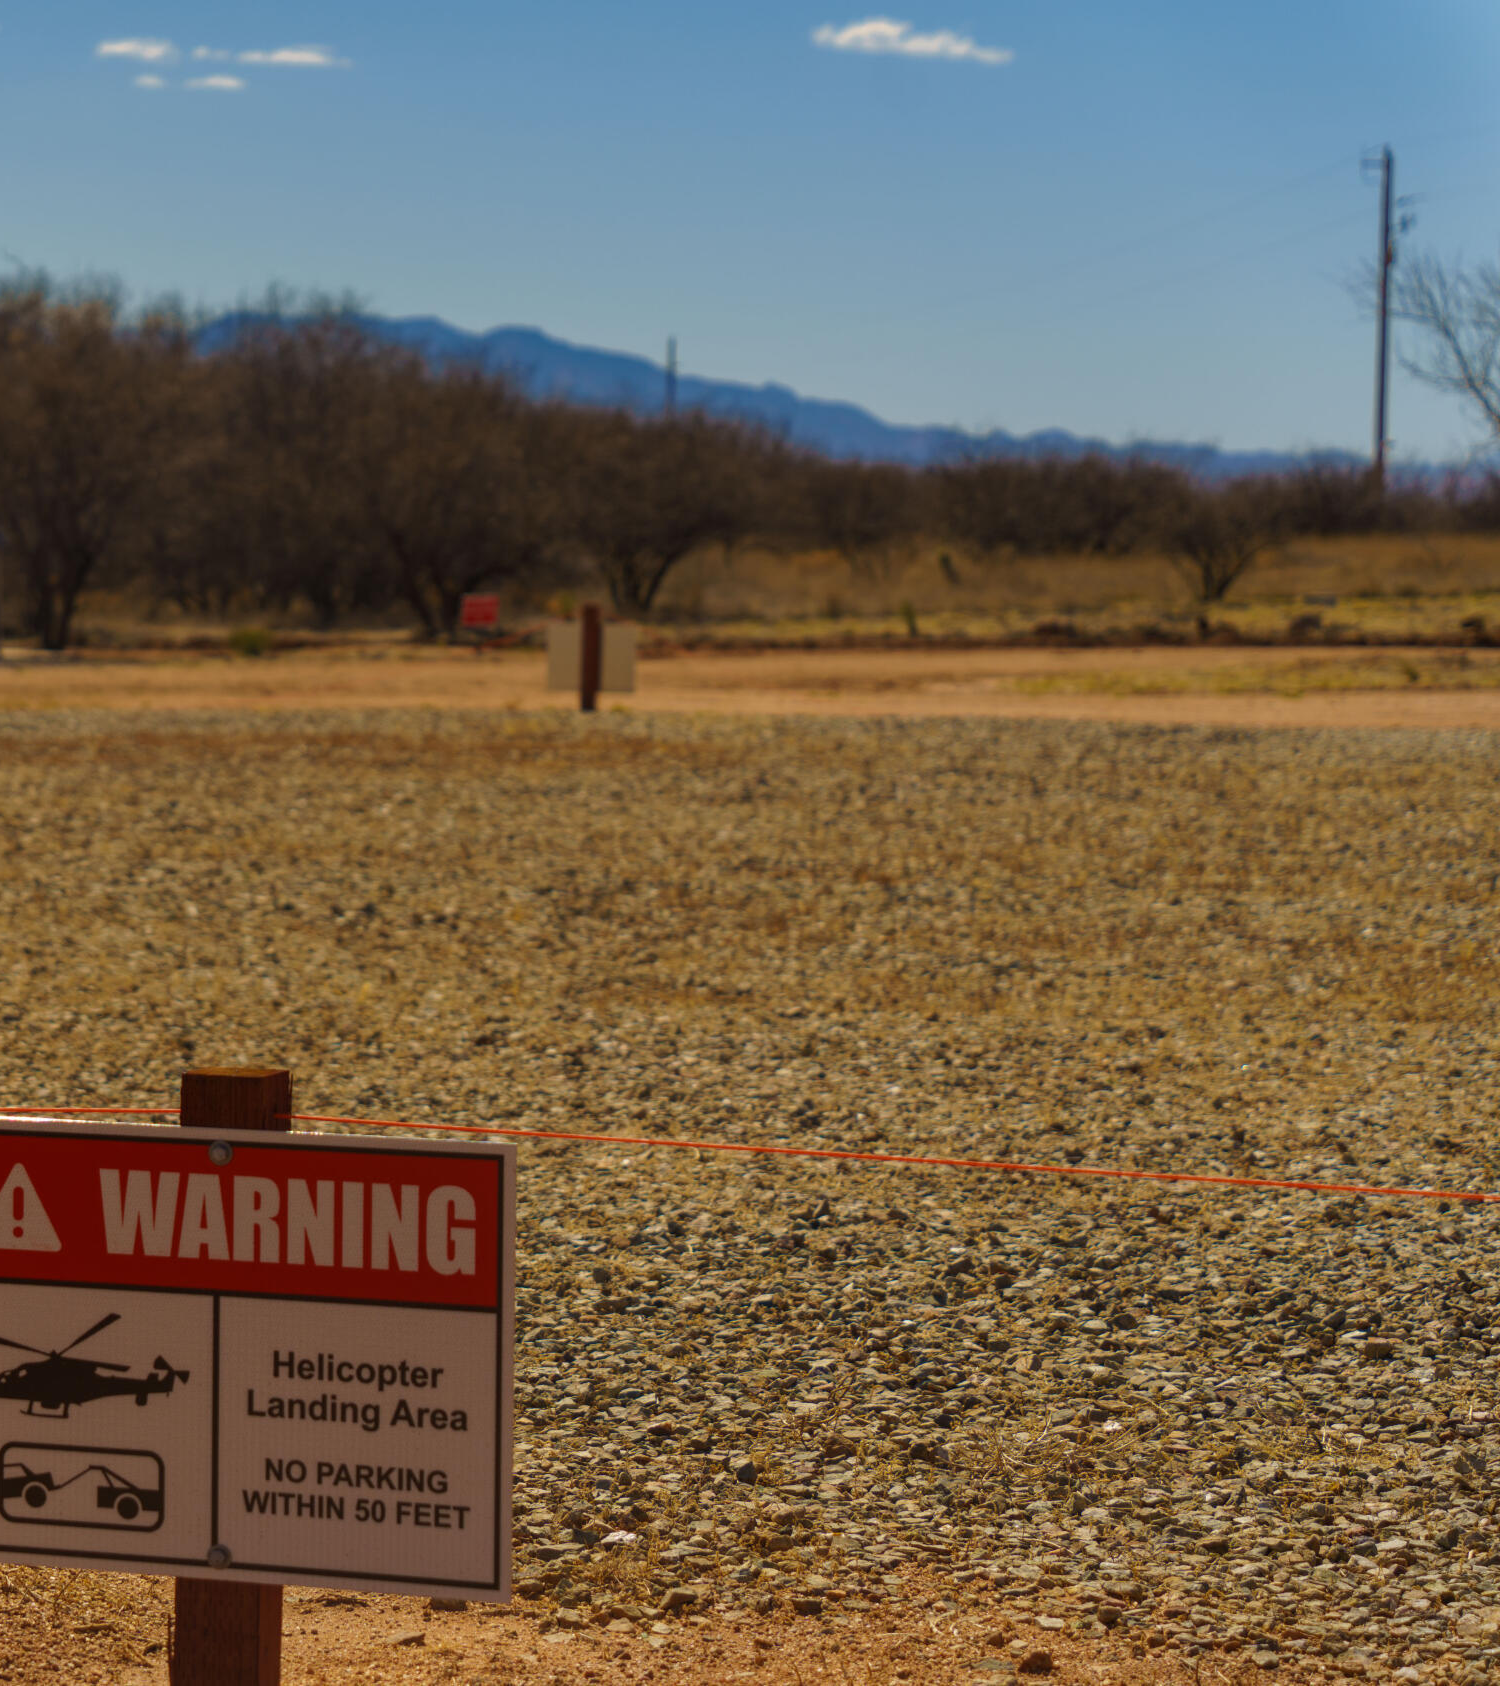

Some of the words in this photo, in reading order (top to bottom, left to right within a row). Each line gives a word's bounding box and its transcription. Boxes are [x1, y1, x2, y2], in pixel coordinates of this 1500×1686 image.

[99, 1168, 476, 1276] WARNING
[272, 1350, 444, 1391] Helicopter
[246, 1390, 380, 1432] Landing
[390, 1399, 468, 1431] Area
[264, 1457, 307, 1484] NO
[316, 1462, 448, 1493] PARKING
[242, 1489, 346, 1521] WITHIN
[354, 1498, 387, 1524] 50
[396, 1501, 471, 1530] FEET
